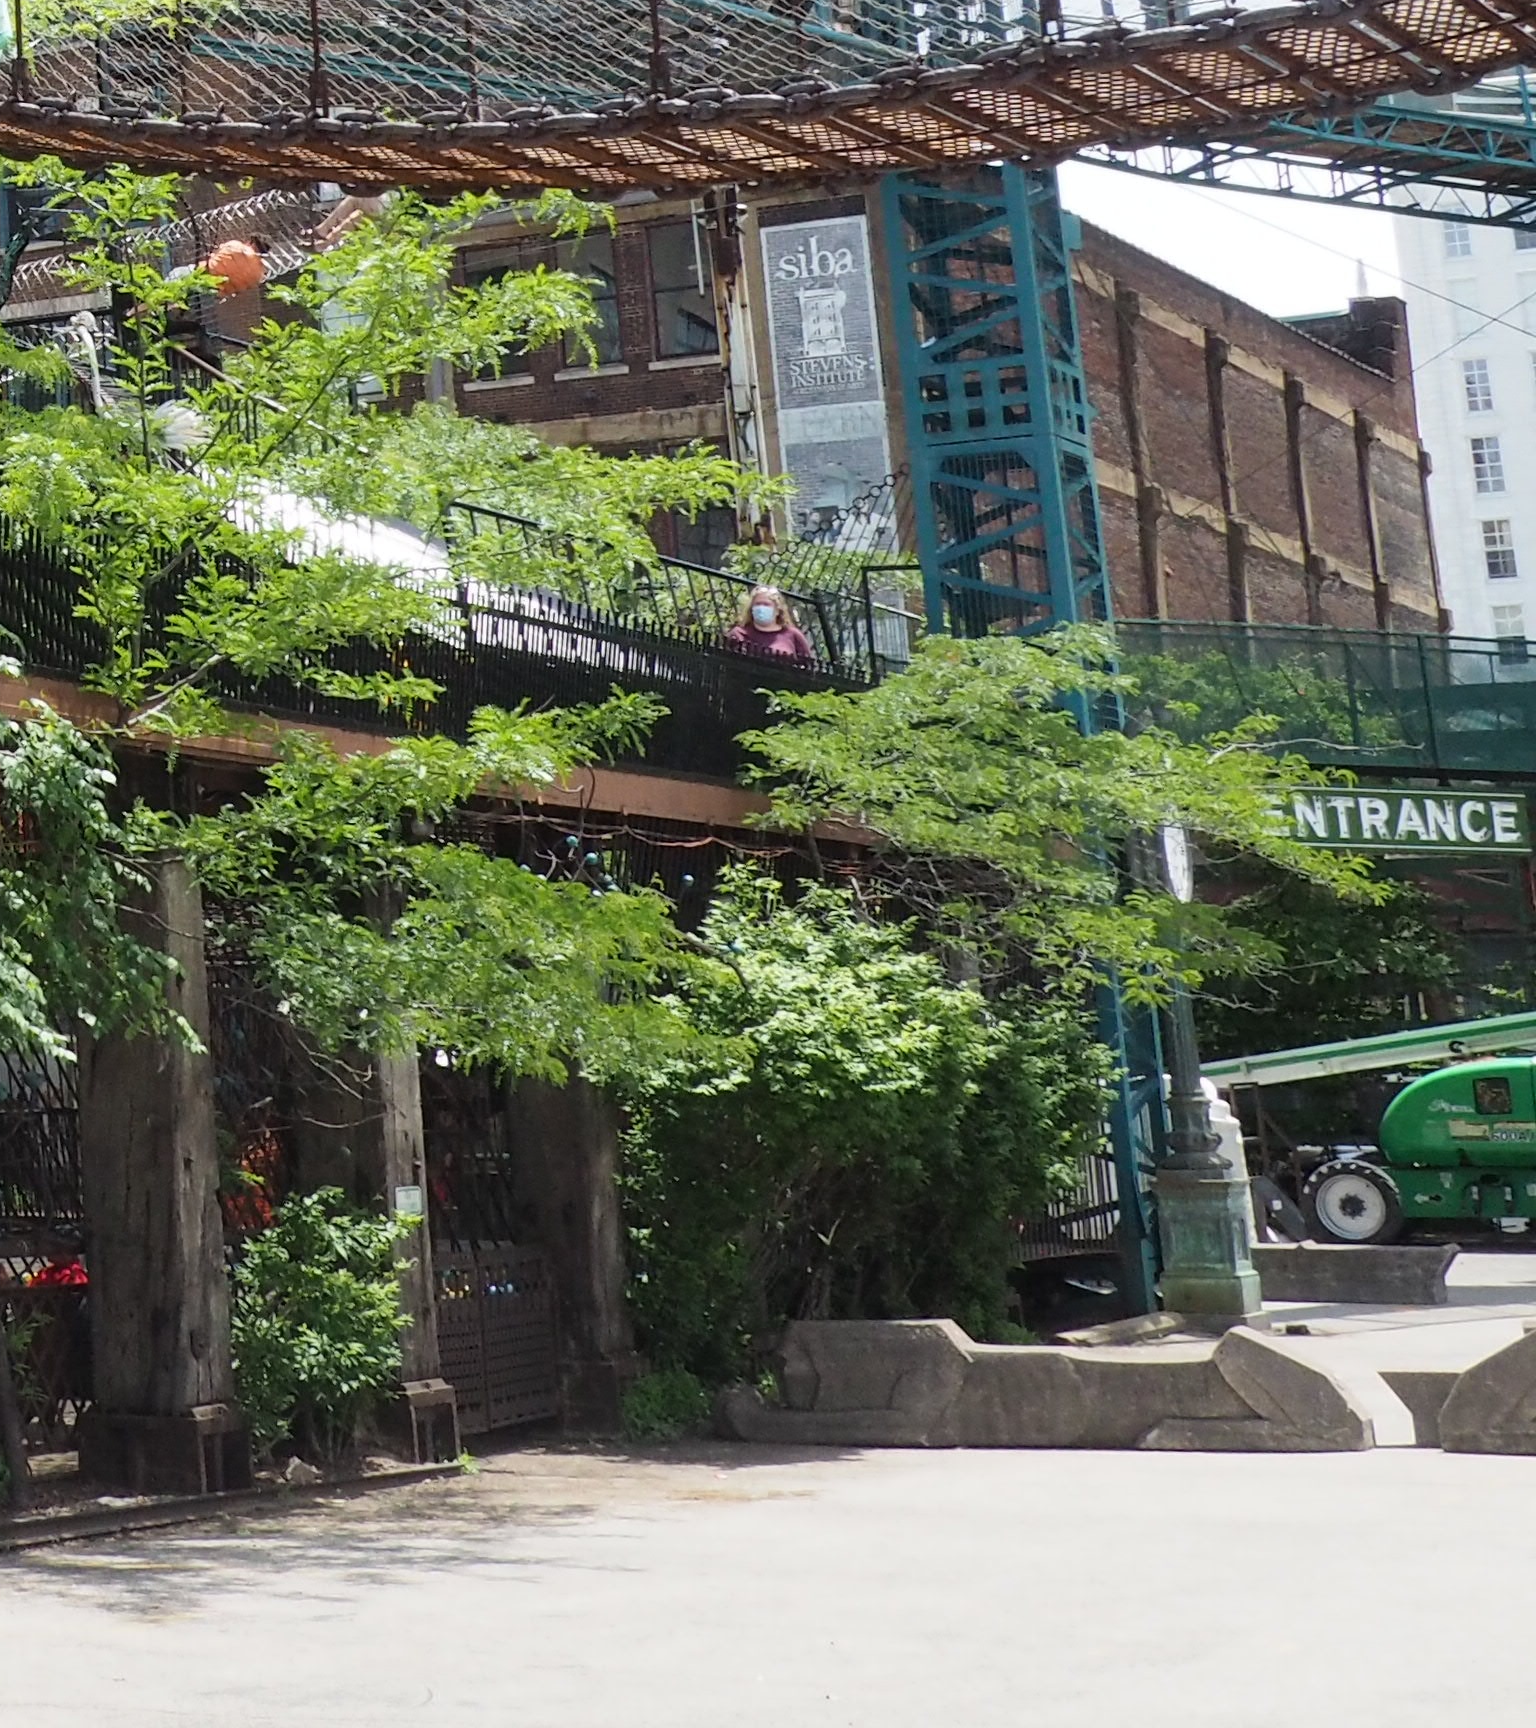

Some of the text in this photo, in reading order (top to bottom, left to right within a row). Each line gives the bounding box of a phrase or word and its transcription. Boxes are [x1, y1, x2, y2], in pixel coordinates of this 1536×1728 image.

[774, 235, 858, 280] siba
[789, 354, 866, 375] STEVENS
[790, 370, 865, 388] INSTITUTE
